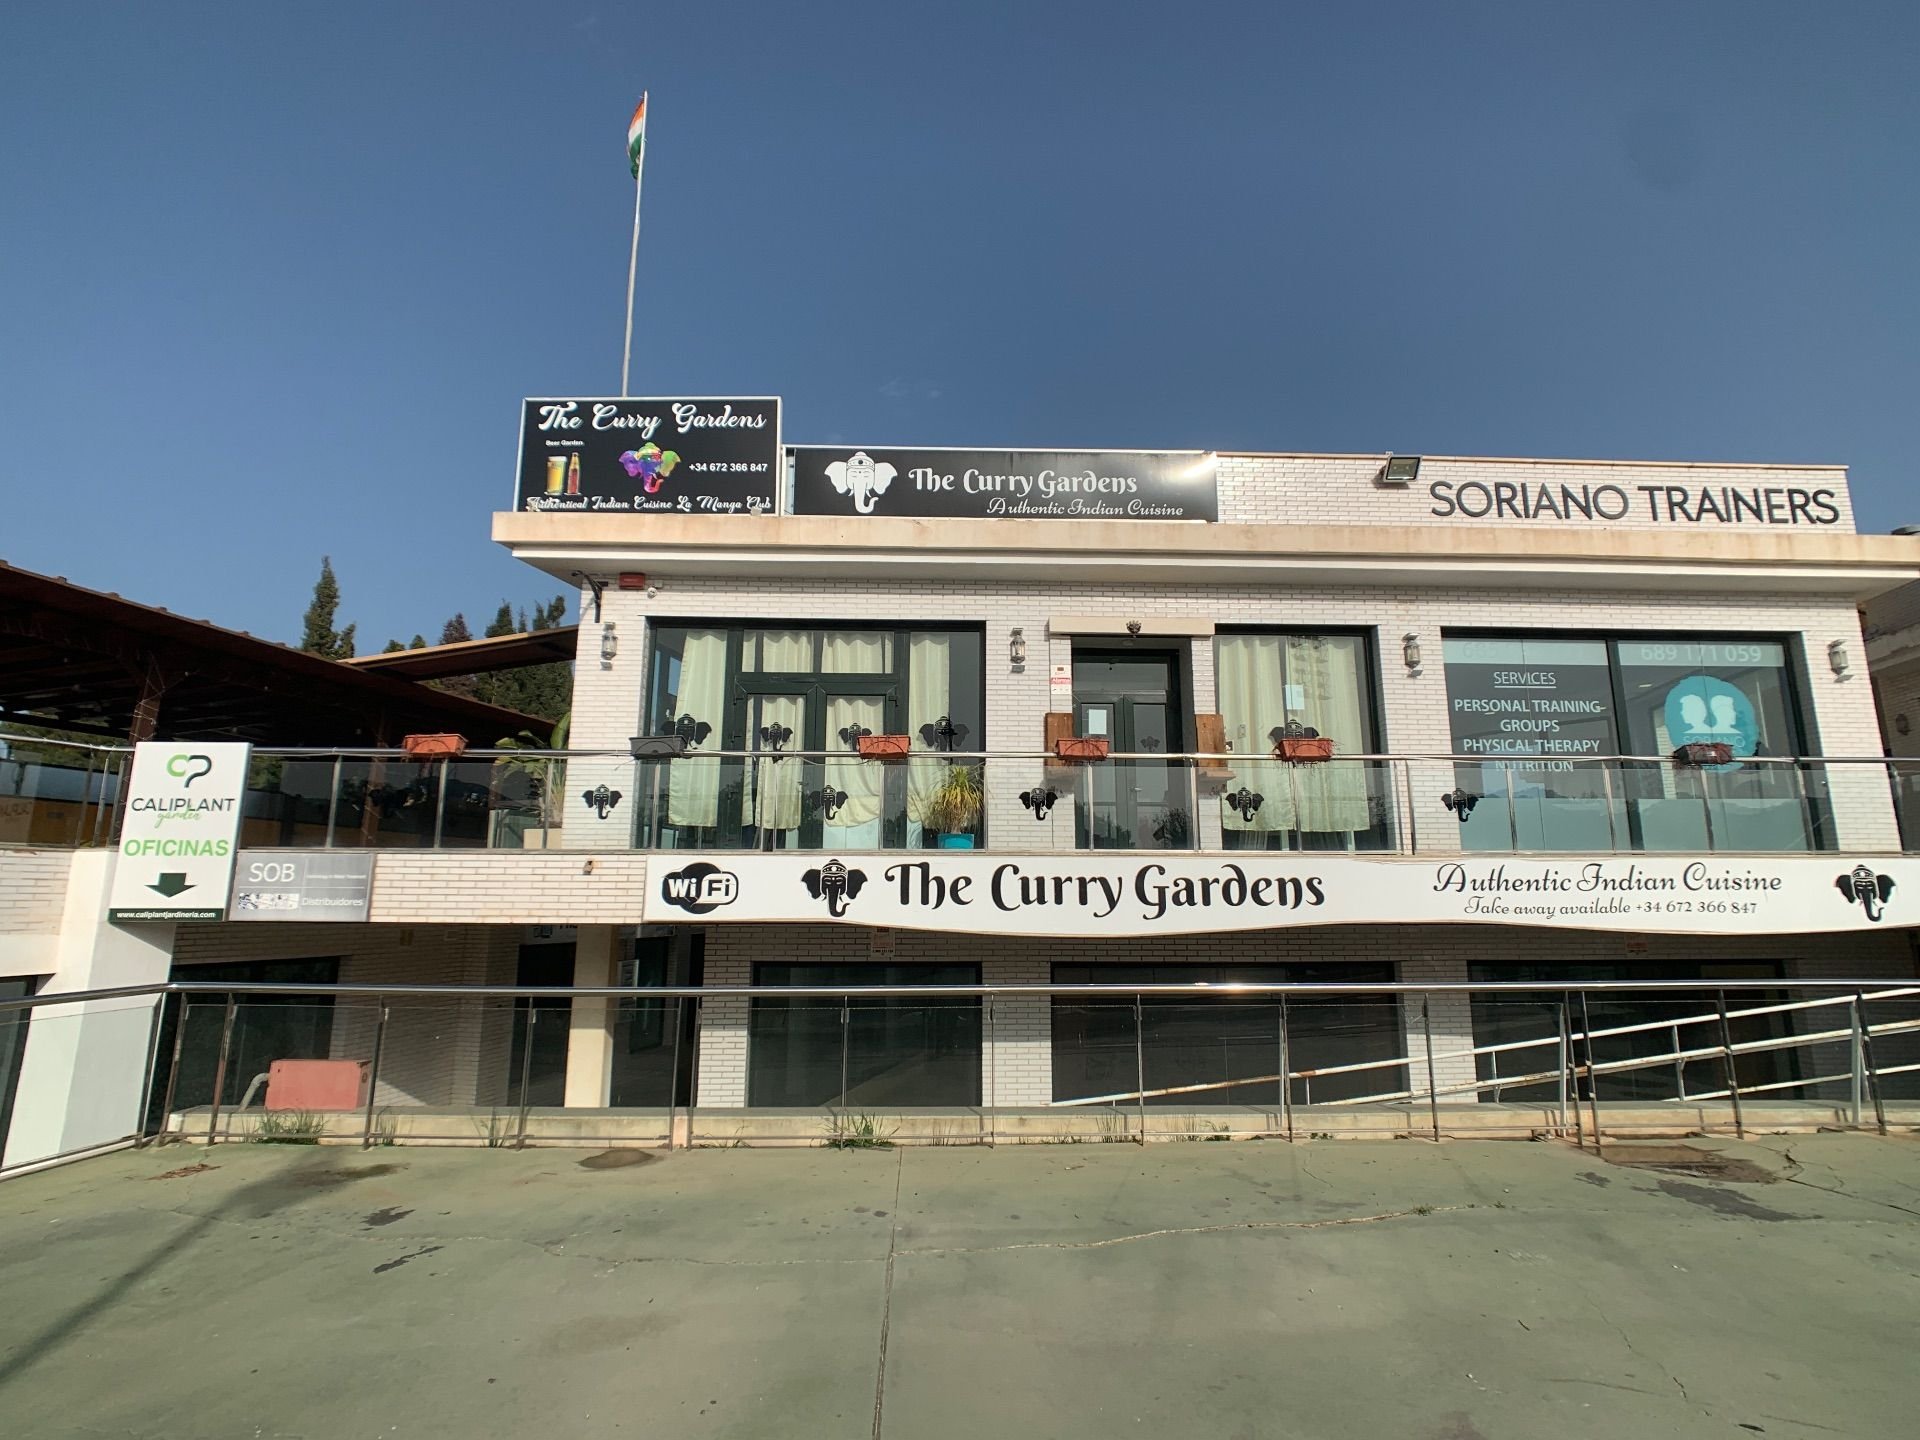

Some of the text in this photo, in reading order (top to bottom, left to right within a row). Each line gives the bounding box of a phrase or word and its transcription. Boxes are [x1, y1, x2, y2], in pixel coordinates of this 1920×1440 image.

[538, 401, 767, 439] The Curry Gardens
[689, 463, 768, 472] +34 672 366 847
[908, 468, 1137, 498] The Curry Gardens
[592, 496, 629, 510] Indian
[633, 496, 672, 510] Cuisine
[677, 495, 692, 512] La
[696, 496, 742, 514] Manga
[746, 495, 771, 510] Club
[987, 497, 1183, 515] Authentic Indian Cuisine
[1429, 480, 1840, 524] SORIANO TRAINERS
[1641, 645, 1677, 660] 689
[1725, 646, 1761, 662] 059
[1493, 671, 1556, 686] SERVICES
[1454, 699, 1601, 714] PERSONAL TRAINING
[1500, 719, 1559, 733] GROUPS
[1463, 738, 1601, 753] PHYSICAL THERAPY
[131, 797, 235, 812] CALIPLANT
[123, 839, 229, 857] OFICINAS
[248, 863, 296, 882] SOB
[1433, 861, 1782, 893] Authentic Indian Cuisine
[884, 861, 1325, 920] The Curry Gardens
[301, 896, 364, 907] Distribuidores
[1464, 895, 1757, 919] Take away available +34 672 366 847
[116, 911, 217, 919] www.caliplantjardineria.com
